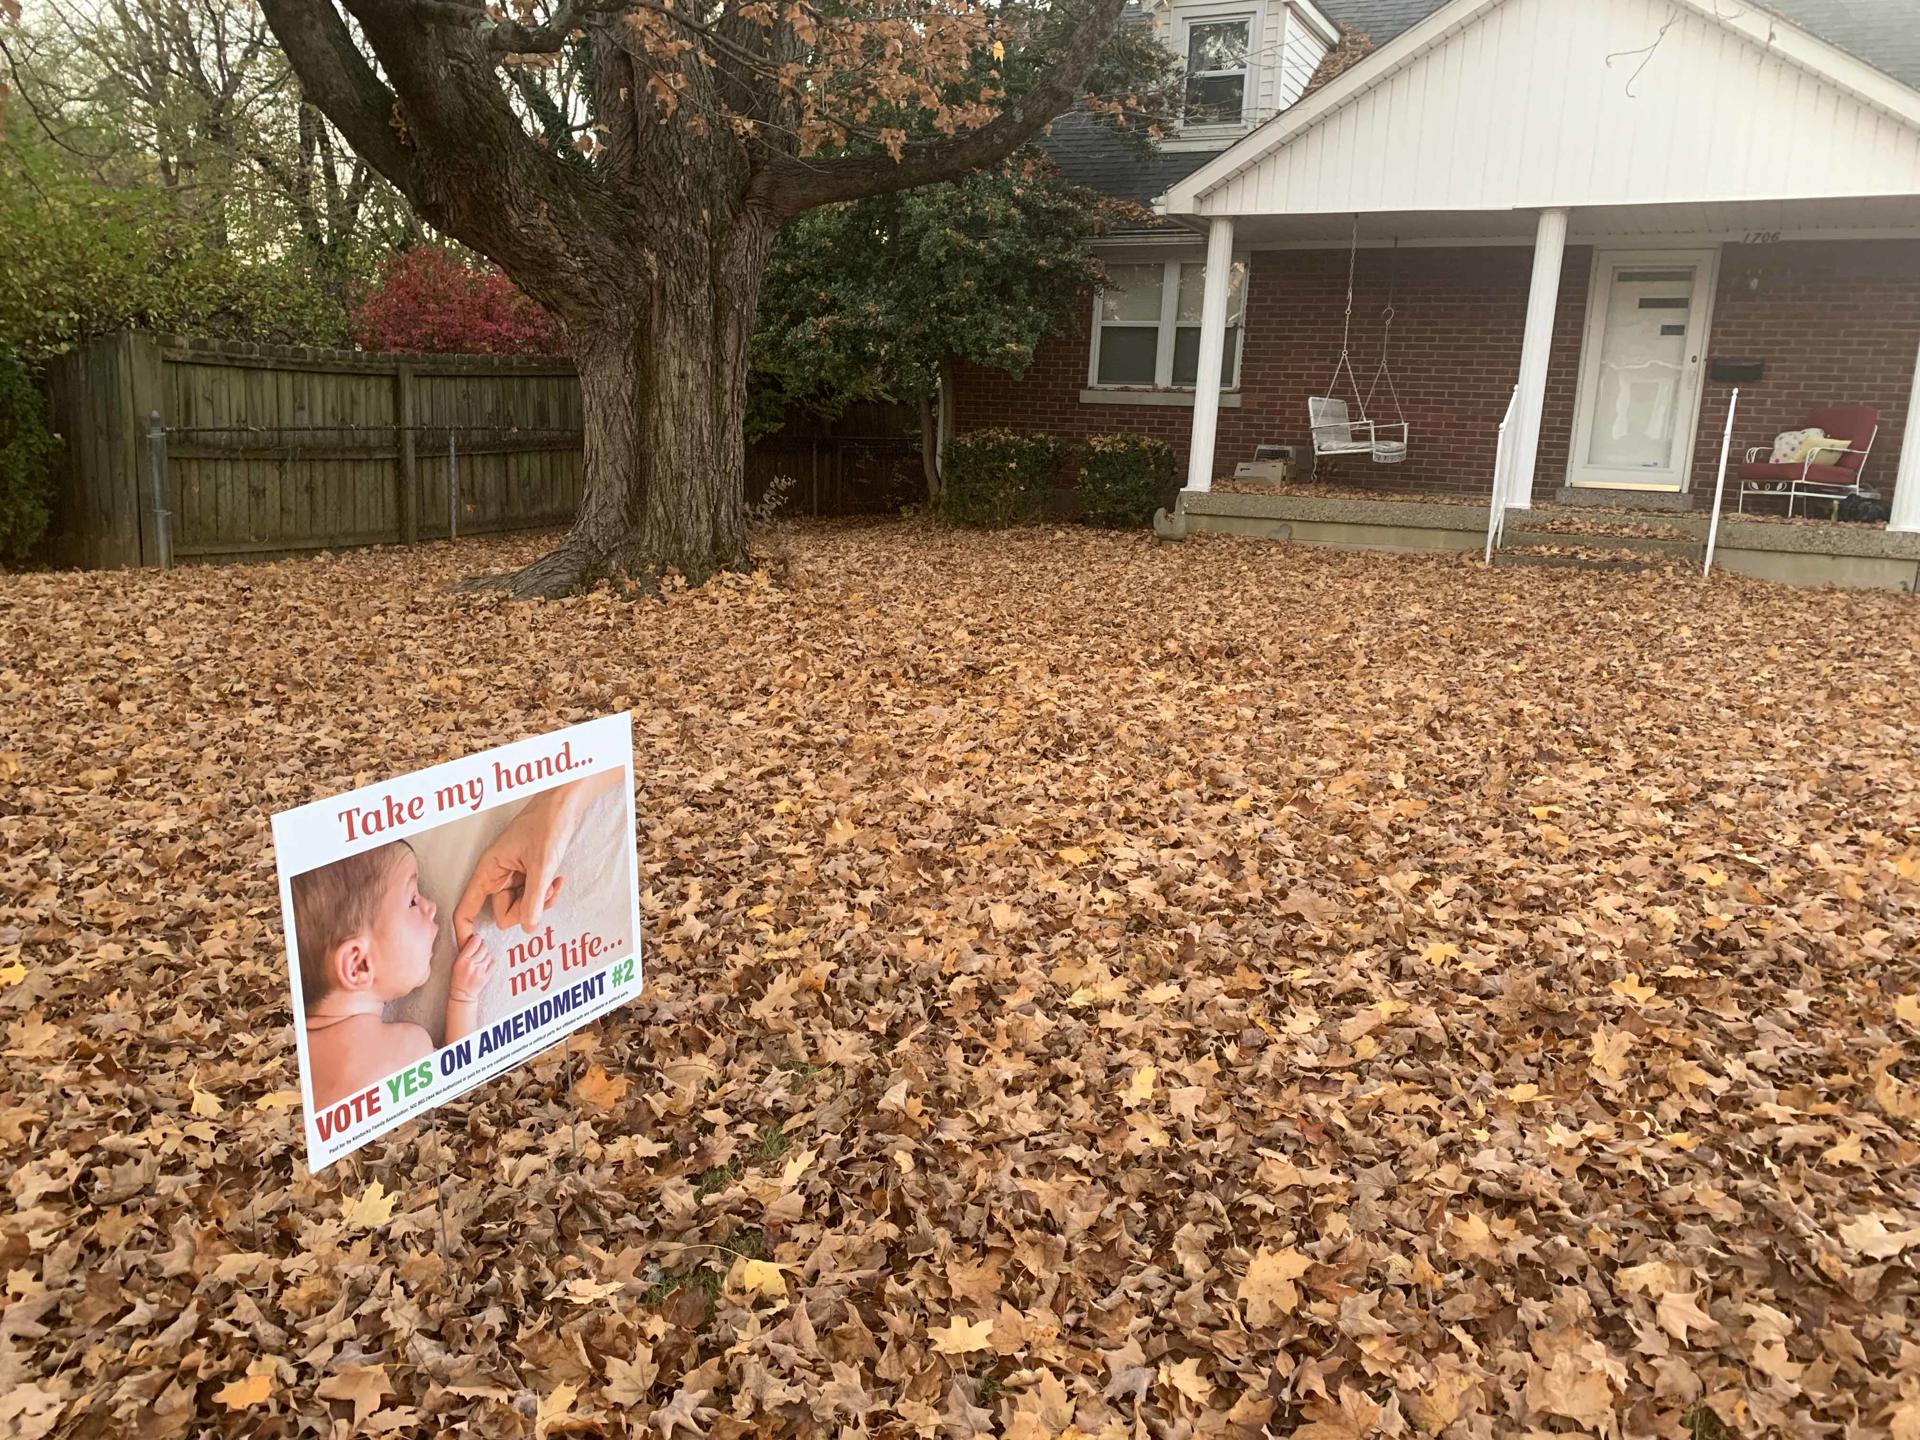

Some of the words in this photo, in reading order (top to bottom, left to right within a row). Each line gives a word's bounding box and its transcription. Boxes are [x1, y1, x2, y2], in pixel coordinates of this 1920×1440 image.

[339, 795, 424, 842] Take
[435, 776, 484, 811] my
[494, 742, 594, 793] hand...
[507, 926, 554, 968] not
[509, 960, 553, 997] my
[559, 932, 623, 971] life...
[315, 1087, 381, 1143] VOTE
[387, 1061, 434, 1104] YES
[440, 1040, 472, 1076] ON
[478, 972, 607, 1058] AMENDMENT
[611, 958, 635, 988] #2
[352, 1129, 371, 1141] Kentucky
